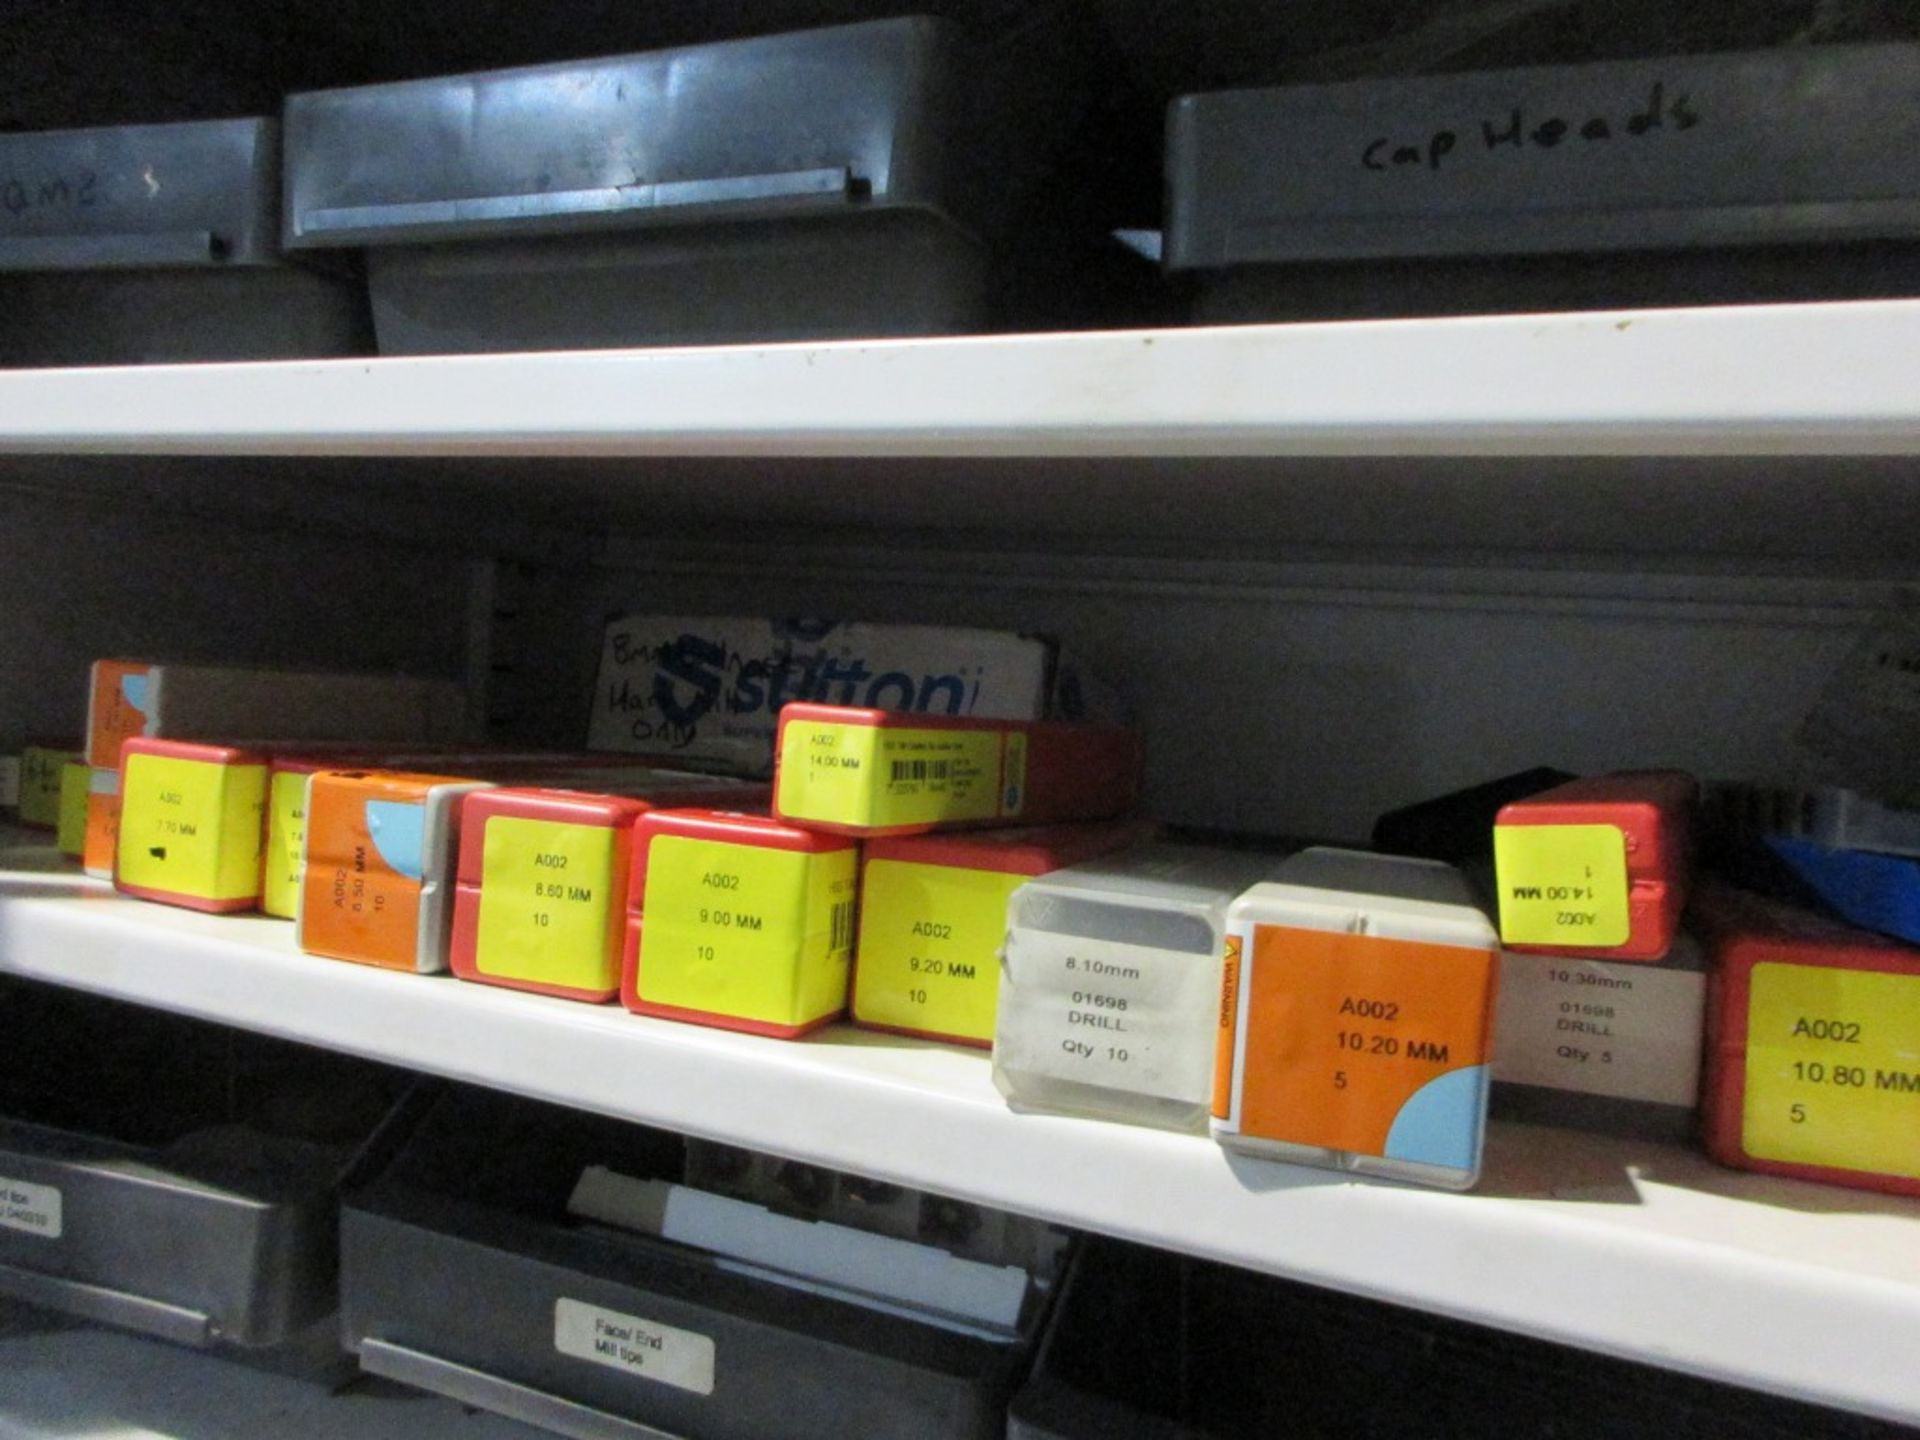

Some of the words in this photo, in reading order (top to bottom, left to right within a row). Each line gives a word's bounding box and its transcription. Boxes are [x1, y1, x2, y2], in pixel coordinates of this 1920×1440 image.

[1482, 82, 1698, 148] Heads
[841, 757, 860, 769] MM
[179, 822, 197, 836] MM
[355, 845, 366, 874] MM
[534, 852, 568, 869] A002
[702, 871, 740, 891] A002
[1584, 864, 1593, 879] 1
[334, 869, 347, 909] A002
[535, 882, 564, 899] 8.60
[567, 886, 592, 902] MM
[1512, 886, 1543, 901] MM
[1546, 886, 1594, 900] 14.00
[533, 912, 549, 927] 10
[699, 908, 731, 927] 9.00
[736, 913, 762, 931] MM
[1555, 912, 1597, 926] A002
[911, 921, 952, 940] A002
[697, 945, 714, 961] 10
[909, 957, 943, 975] 9.20
[947, 962, 976, 979] MM
[1065, 956, 1140, 980] 8.10mm
[909, 989, 927, 1004] 10
[1071, 991, 1128, 1012] 01698
[1220, 961, 1234, 1028] WARNING
[1339, 997, 1399, 1021] A002
[1067, 1010, 1129, 1033] DRILL
[1557, 1018, 1616, 1037] DRILL
[1791, 1017, 1861, 1043] A002
[1061, 1039, 1094, 1059] Qty
[1107, 1047, 1129, 1062] 10
[1337, 1030, 1399, 1056] 10.20
[1406, 1040, 1449, 1064] MM
[1556, 1045, 1591, 1062] Qty
[1334, 1071, 1347, 1090] 5
[1792, 1060, 1867, 1088] 10.80
[1874, 1068, 1920, 1094] MM
[1789, 1103, 1807, 1124] 5
[636, 1329, 663, 1351] End
